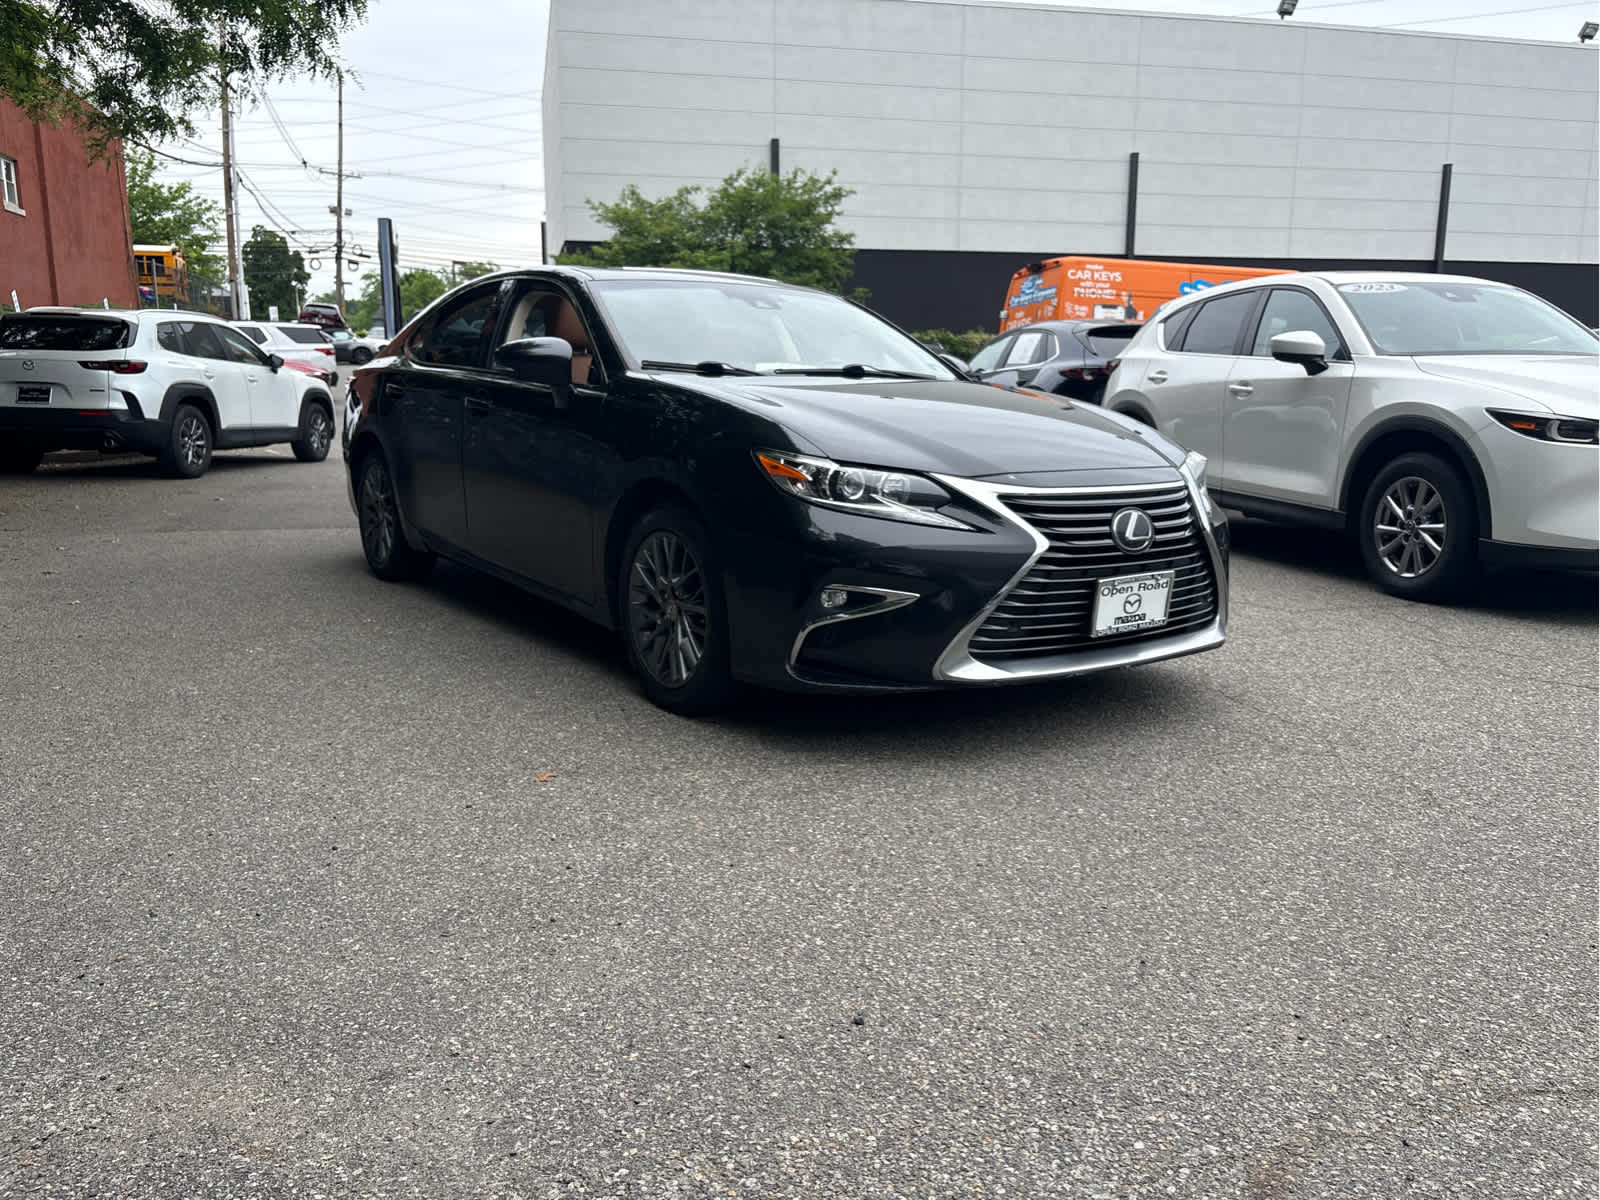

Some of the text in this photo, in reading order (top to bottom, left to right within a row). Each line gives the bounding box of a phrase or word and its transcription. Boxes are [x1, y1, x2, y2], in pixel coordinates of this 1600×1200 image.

[1067, 269, 1122, 282] CAR KEYS
[1352, 284, 1395, 292] 2023
[1101, 586, 1133, 597] Open
[1137, 579, 1168, 591] Road
[1114, 613, 1146, 625] mazda
